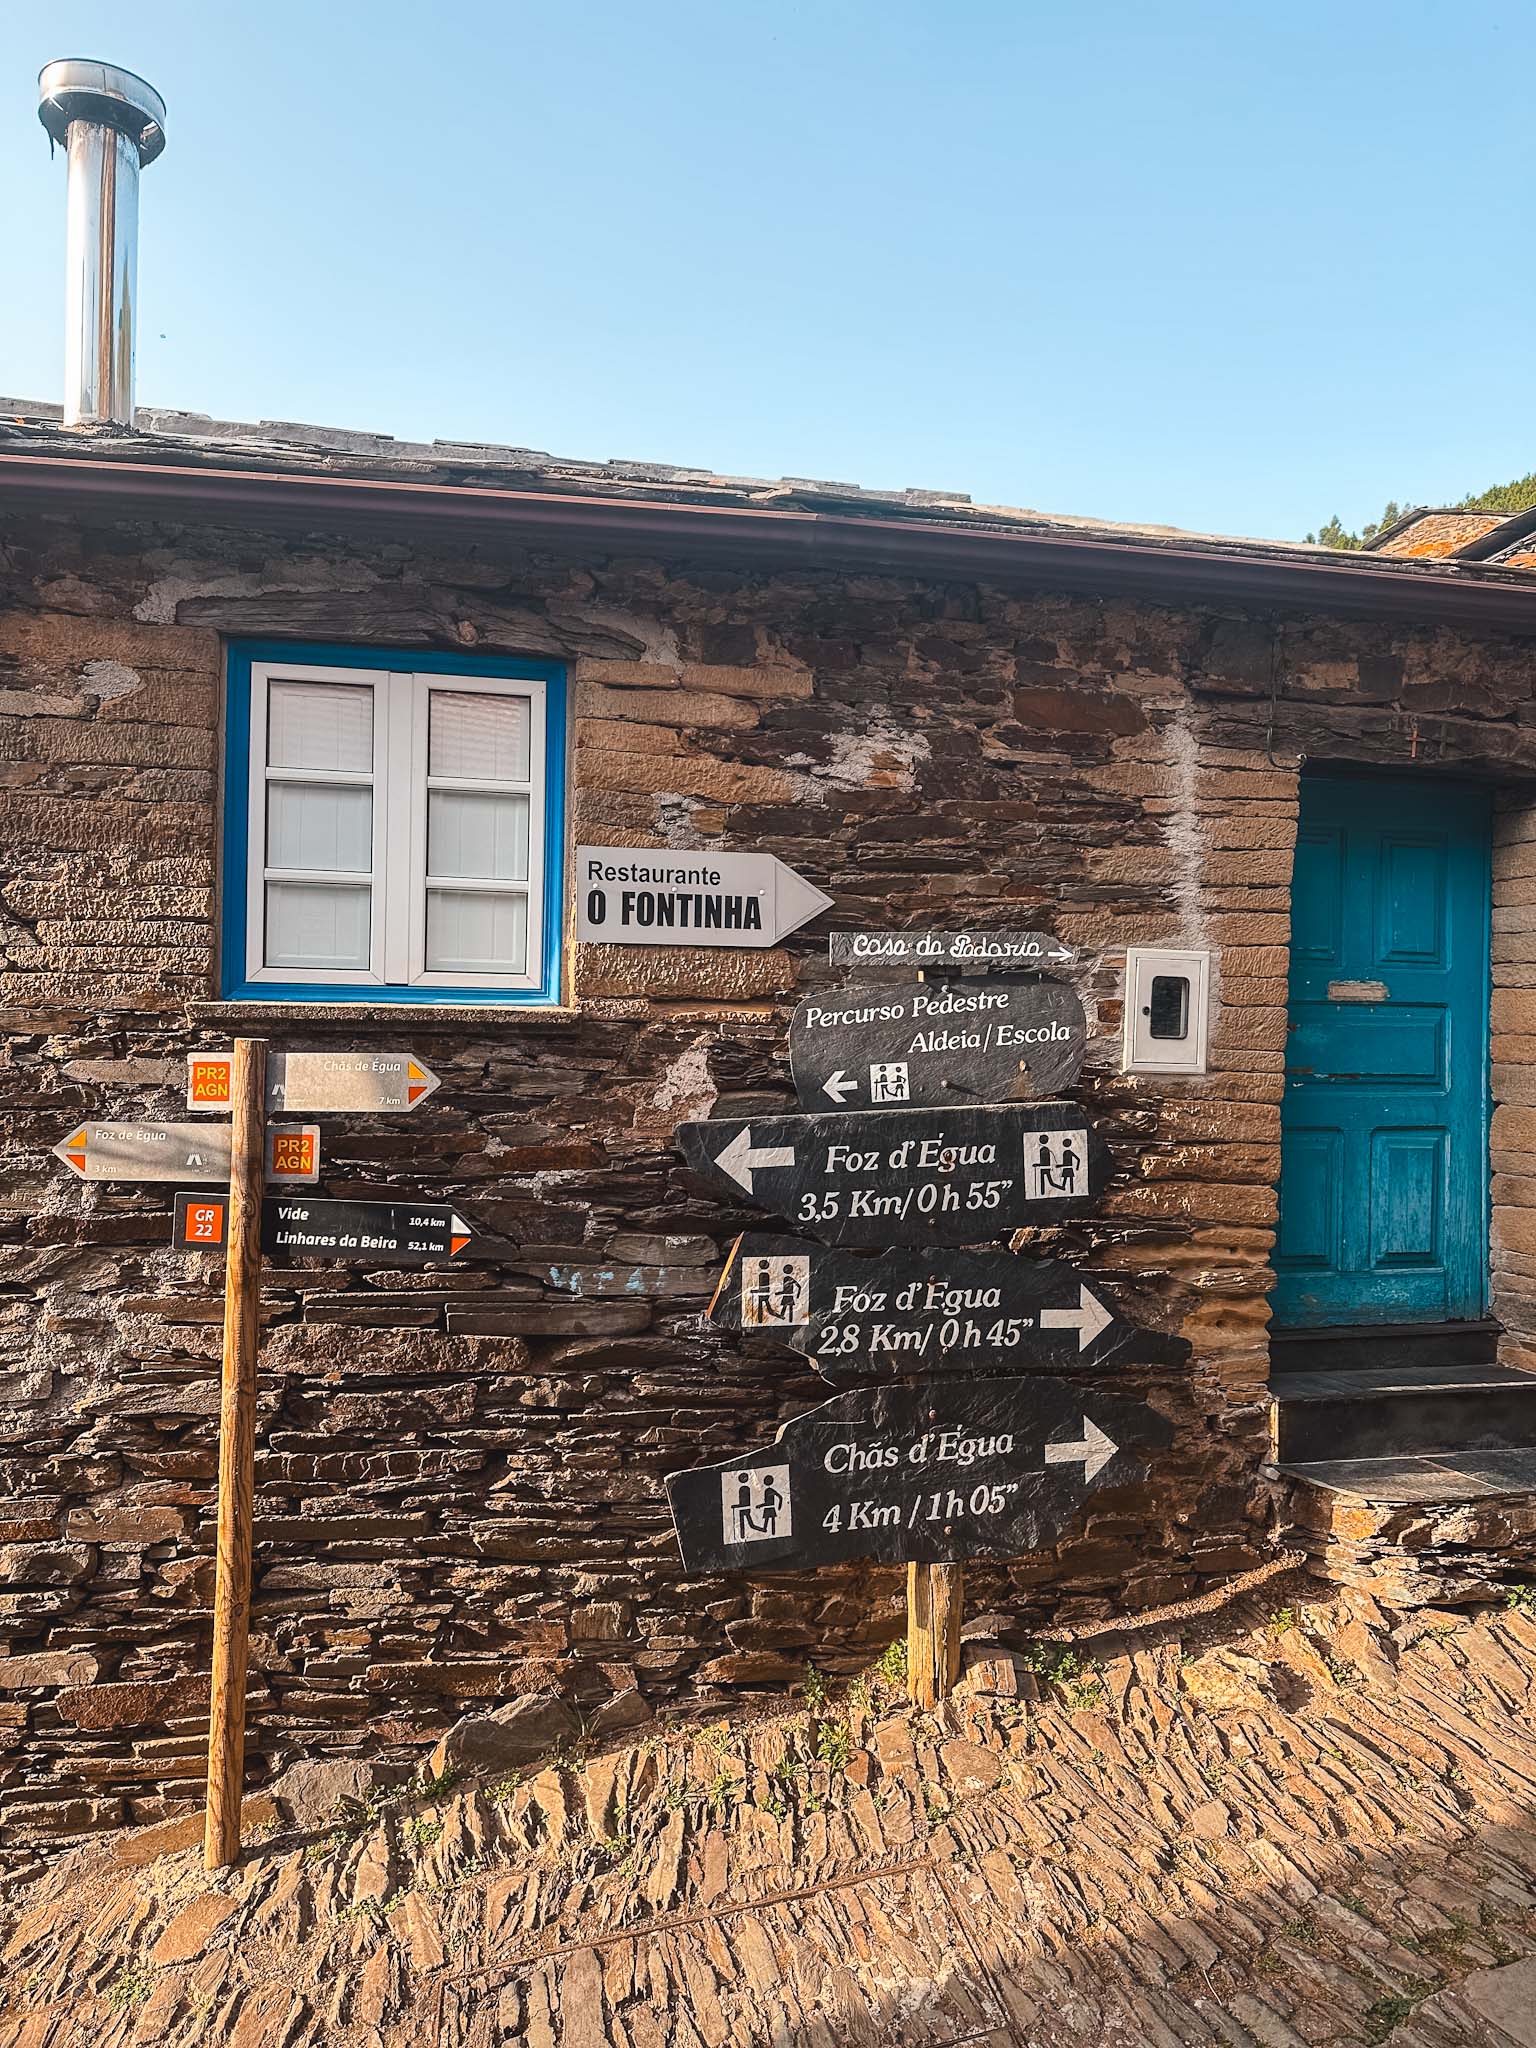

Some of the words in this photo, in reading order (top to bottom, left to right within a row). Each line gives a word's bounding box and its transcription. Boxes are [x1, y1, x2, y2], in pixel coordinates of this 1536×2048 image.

[588, 861, 721, 886] Restaurante
[587, 889, 606, 925] O
[622, 890, 762, 930] FONTINHA
[853, 934, 909, 957] Casa
[916, 934, 945, 956] da
[950, 934, 1044, 958] Padaria
[805, 1004, 904, 1029] Percurso
[912, 991, 1010, 1018] Pedestre
[196, 1067, 226, 1080] PR2
[323, 1059, 352, 1072] Chãs
[355, 1060, 369, 1072] de
[372, 1058, 401, 1074] Égua
[195, 1083, 228, 1097] AGN
[379, 1097, 384, 1105] 7
[386, 1097, 401, 1105] km
[95, 1129, 116, 1141] Foz
[118, 1129, 133, 1141] de
[136, 1127, 166, 1144] Égua
[277, 1139, 310, 1153] PR2
[824, 1145, 880, 1173] Foz
[888, 1132, 996, 1173] d'Égua
[102, 1164, 117, 1174] km
[275, 1155, 312, 1169] AGN
[278, 1207, 309, 1221] Vide
[797, 1191, 841, 1223] 3,5
[194, 1209, 214, 1222] GR
[409, 1217, 429, 1228] 10,4
[430, 1218, 446, 1228] km
[194, 1224, 213, 1237] 22
[276, 1231, 336, 1247] Linhares
[339, 1234, 357, 1248] da
[361, 1235, 397, 1250] Beira
[407, 1241, 427, 1252] 52,1
[428, 1242, 445, 1252] km
[832, 1285, 888, 1314] Foz
[816, 1324, 860, 1357] 2,8
[823, 1441, 899, 1474] Chãs
[908, 1424, 1014, 1466] d'Égua
[822, 1504, 842, 1533] 4
[847, 1501, 901, 1530] Km
